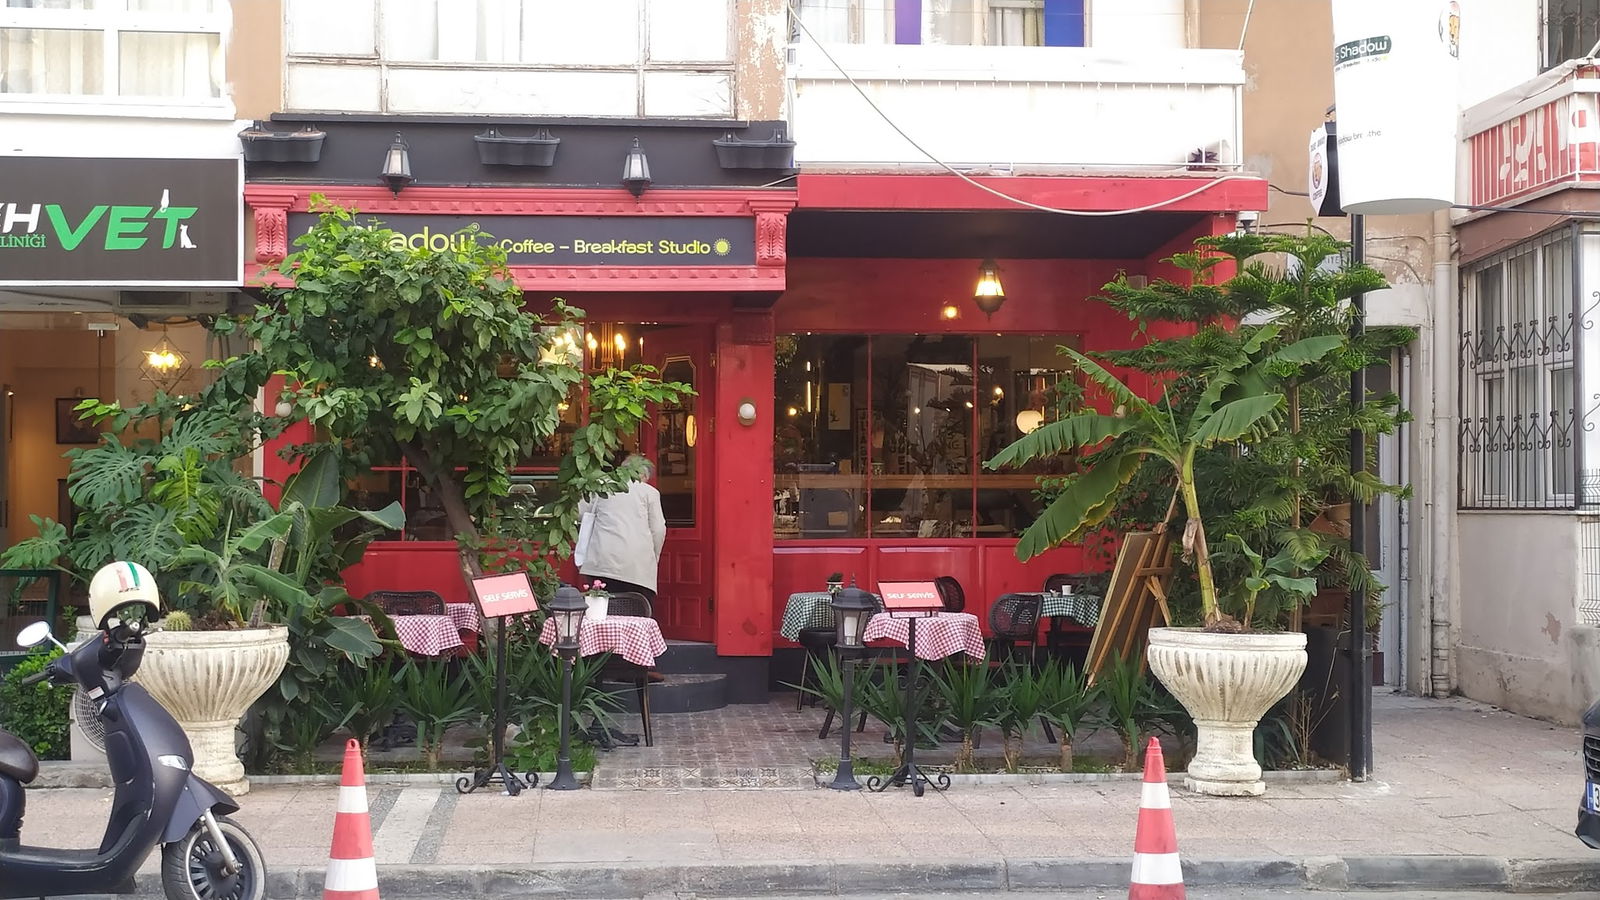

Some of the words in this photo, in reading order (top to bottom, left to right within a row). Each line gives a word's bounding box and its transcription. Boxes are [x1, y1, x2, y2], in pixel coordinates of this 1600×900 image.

[1340, 39, 1387, 59] Shadow
[501, 239, 555, 254] Coffee
[574, 239, 653, 254] Breakfast
[658, 239, 711, 254] Studio
[483, 593, 500, 602] SELF
